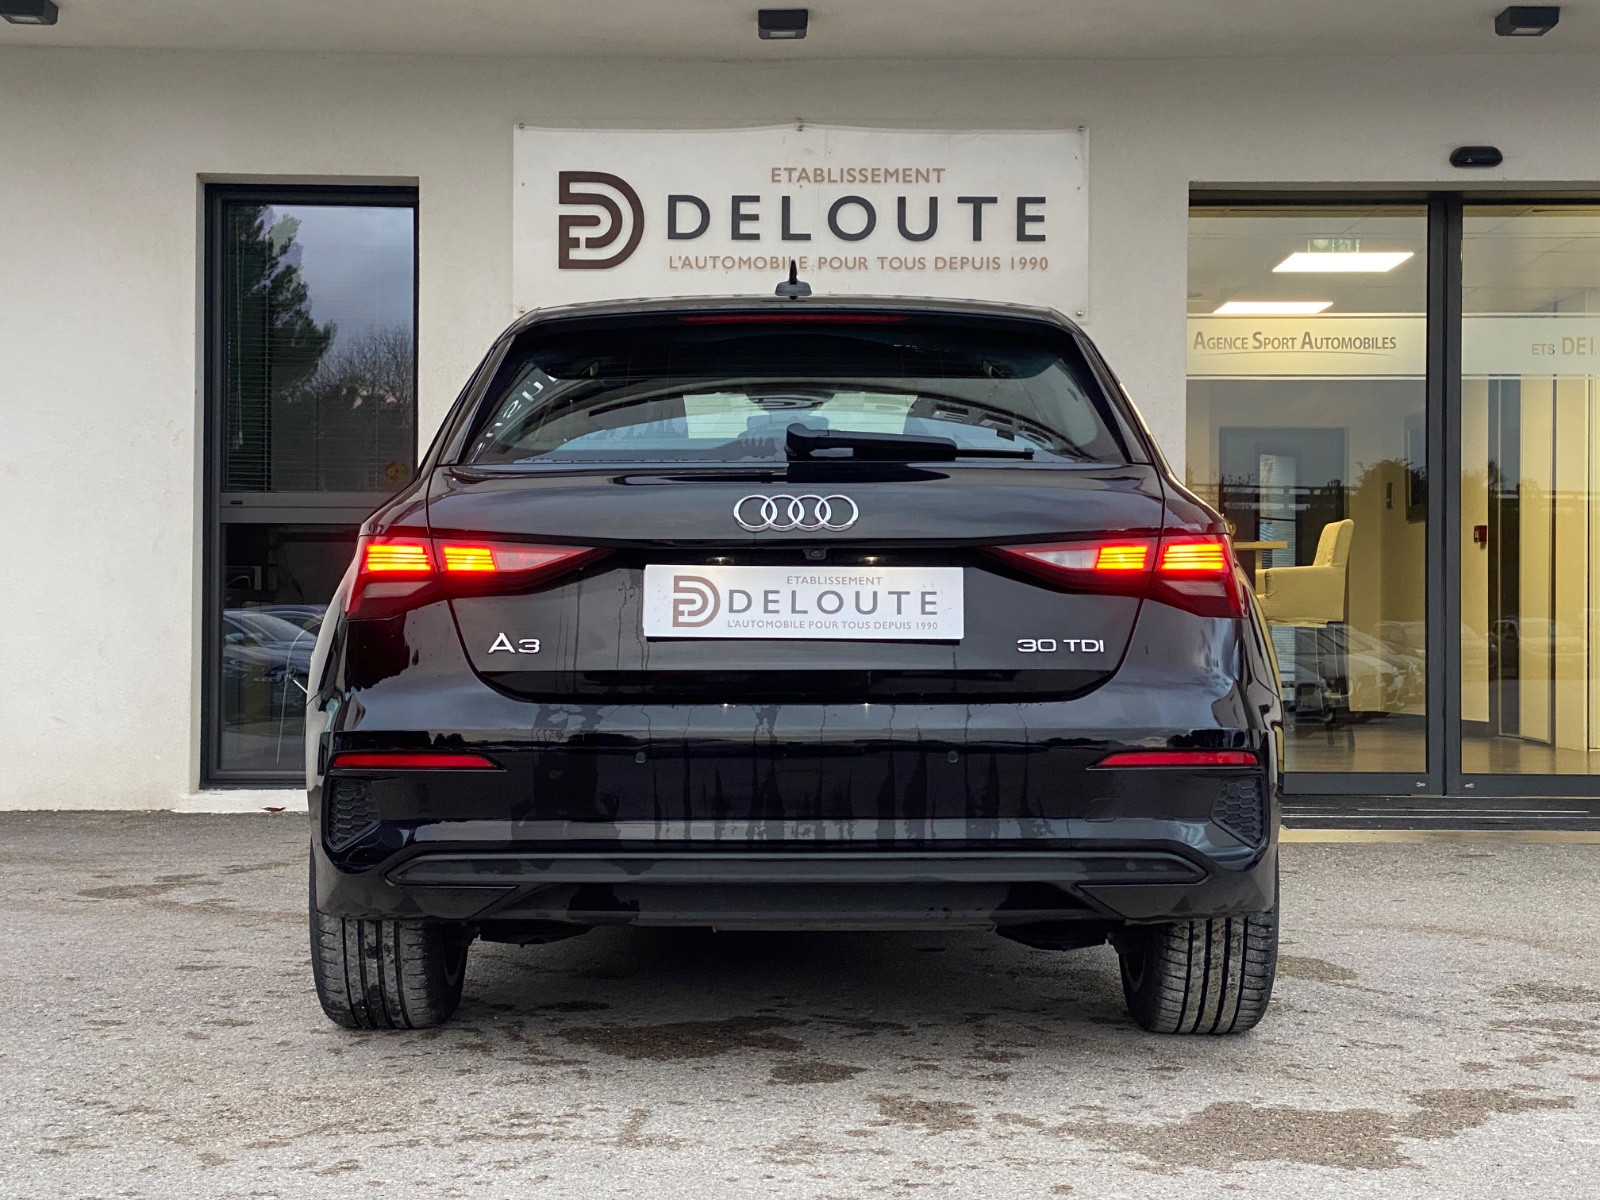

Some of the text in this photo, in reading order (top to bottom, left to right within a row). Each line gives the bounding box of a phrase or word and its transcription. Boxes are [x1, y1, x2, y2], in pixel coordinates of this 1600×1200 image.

[771, 167, 946, 185] ETABLISSEMENT
[667, 194, 1047, 242] DELOUTE
[818, 256, 869, 271] POUR
[877, 256, 927, 271] TOUS
[934, 256, 1001, 271] DEPUIS
[1010, 256, 1049, 271] 1990
[1531, 343, 1556, 356] ETS
[786, 575, 884, 586] ETABLISSEMENT
[728, 589, 938, 615] DELOUTE
[727, 620, 938, 630] L'AUTOMOBILE POUR TOUS DEPUIS 1990
[487, 632, 541, 654] A3
[1017, 638, 1105, 653] 30 TDI
